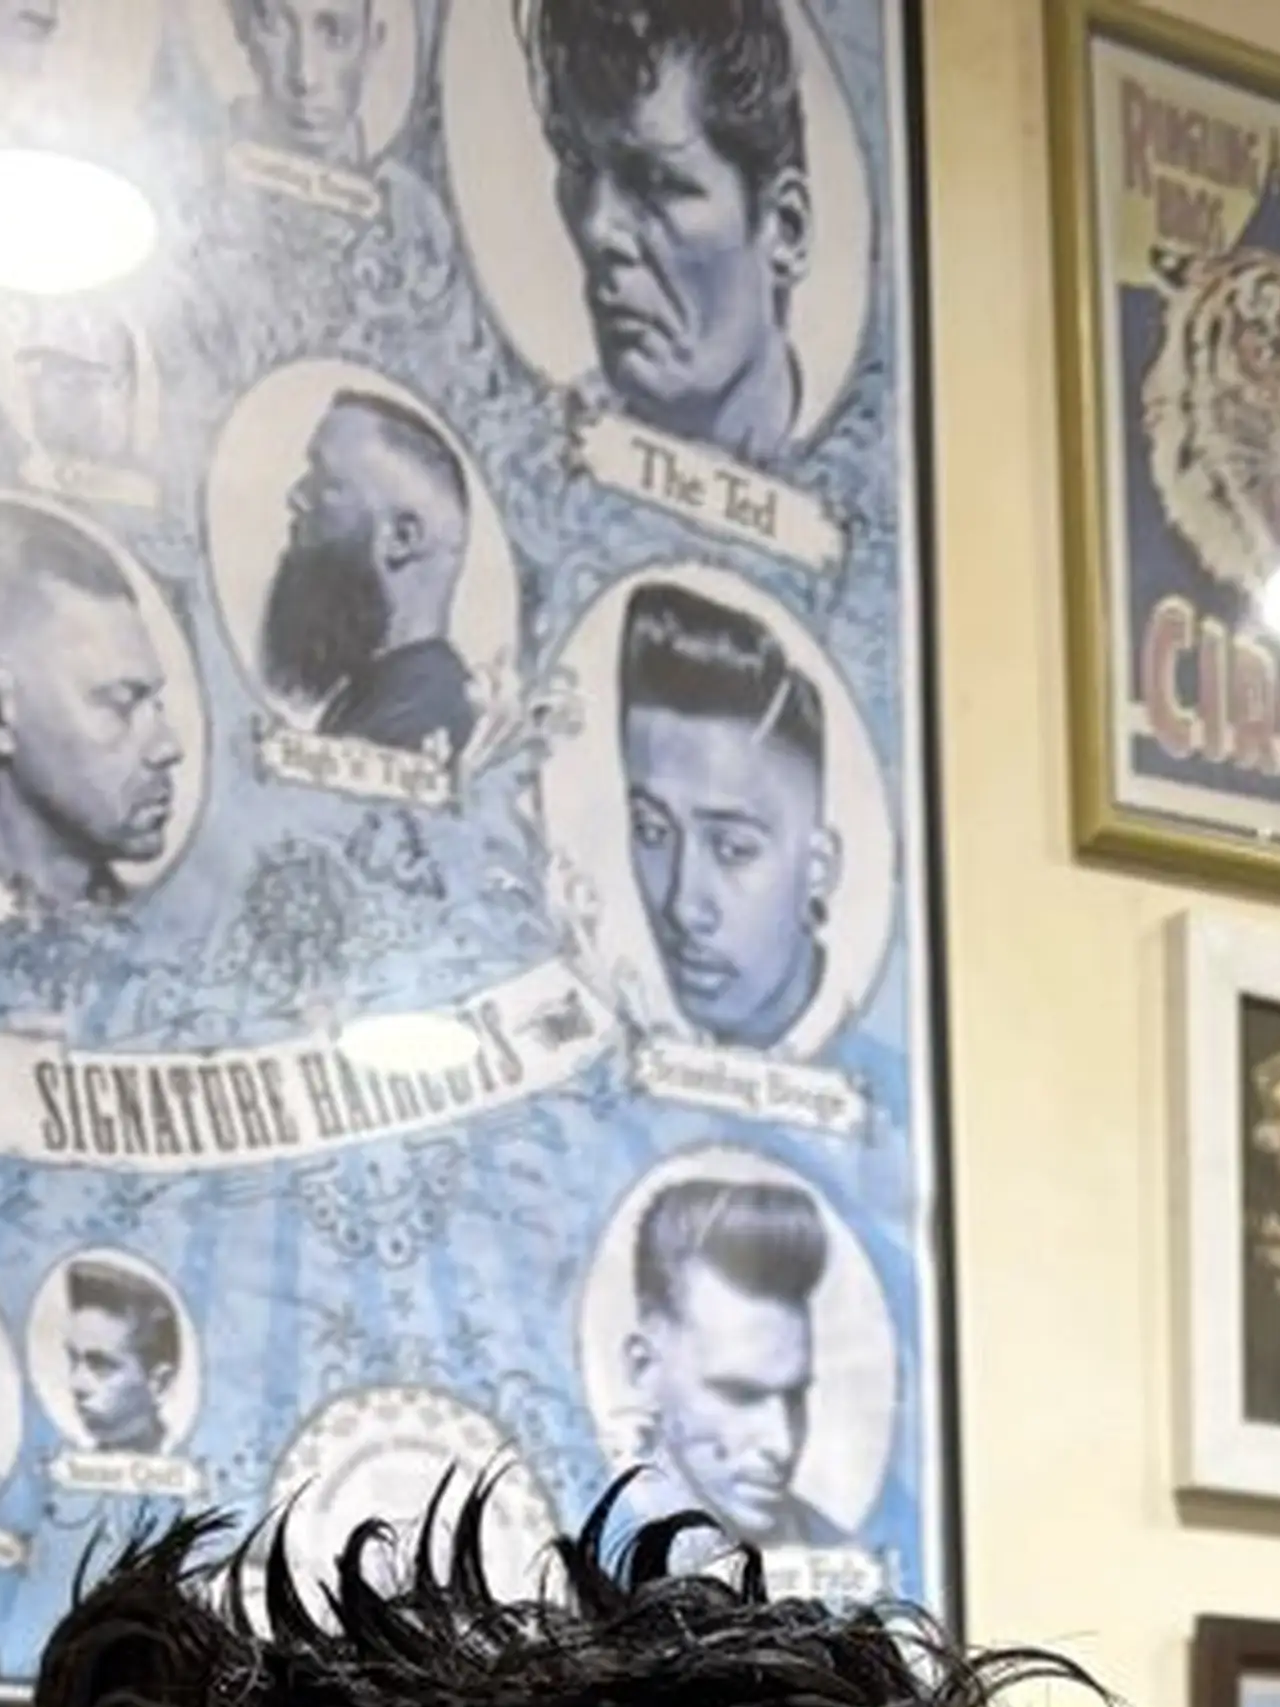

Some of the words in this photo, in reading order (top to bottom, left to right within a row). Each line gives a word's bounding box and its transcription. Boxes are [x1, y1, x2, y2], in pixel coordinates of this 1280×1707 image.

[630, 436, 707, 507] The
[714, 468, 778, 541] Ted
[34, 1057, 300, 1156] SIGNATURE
